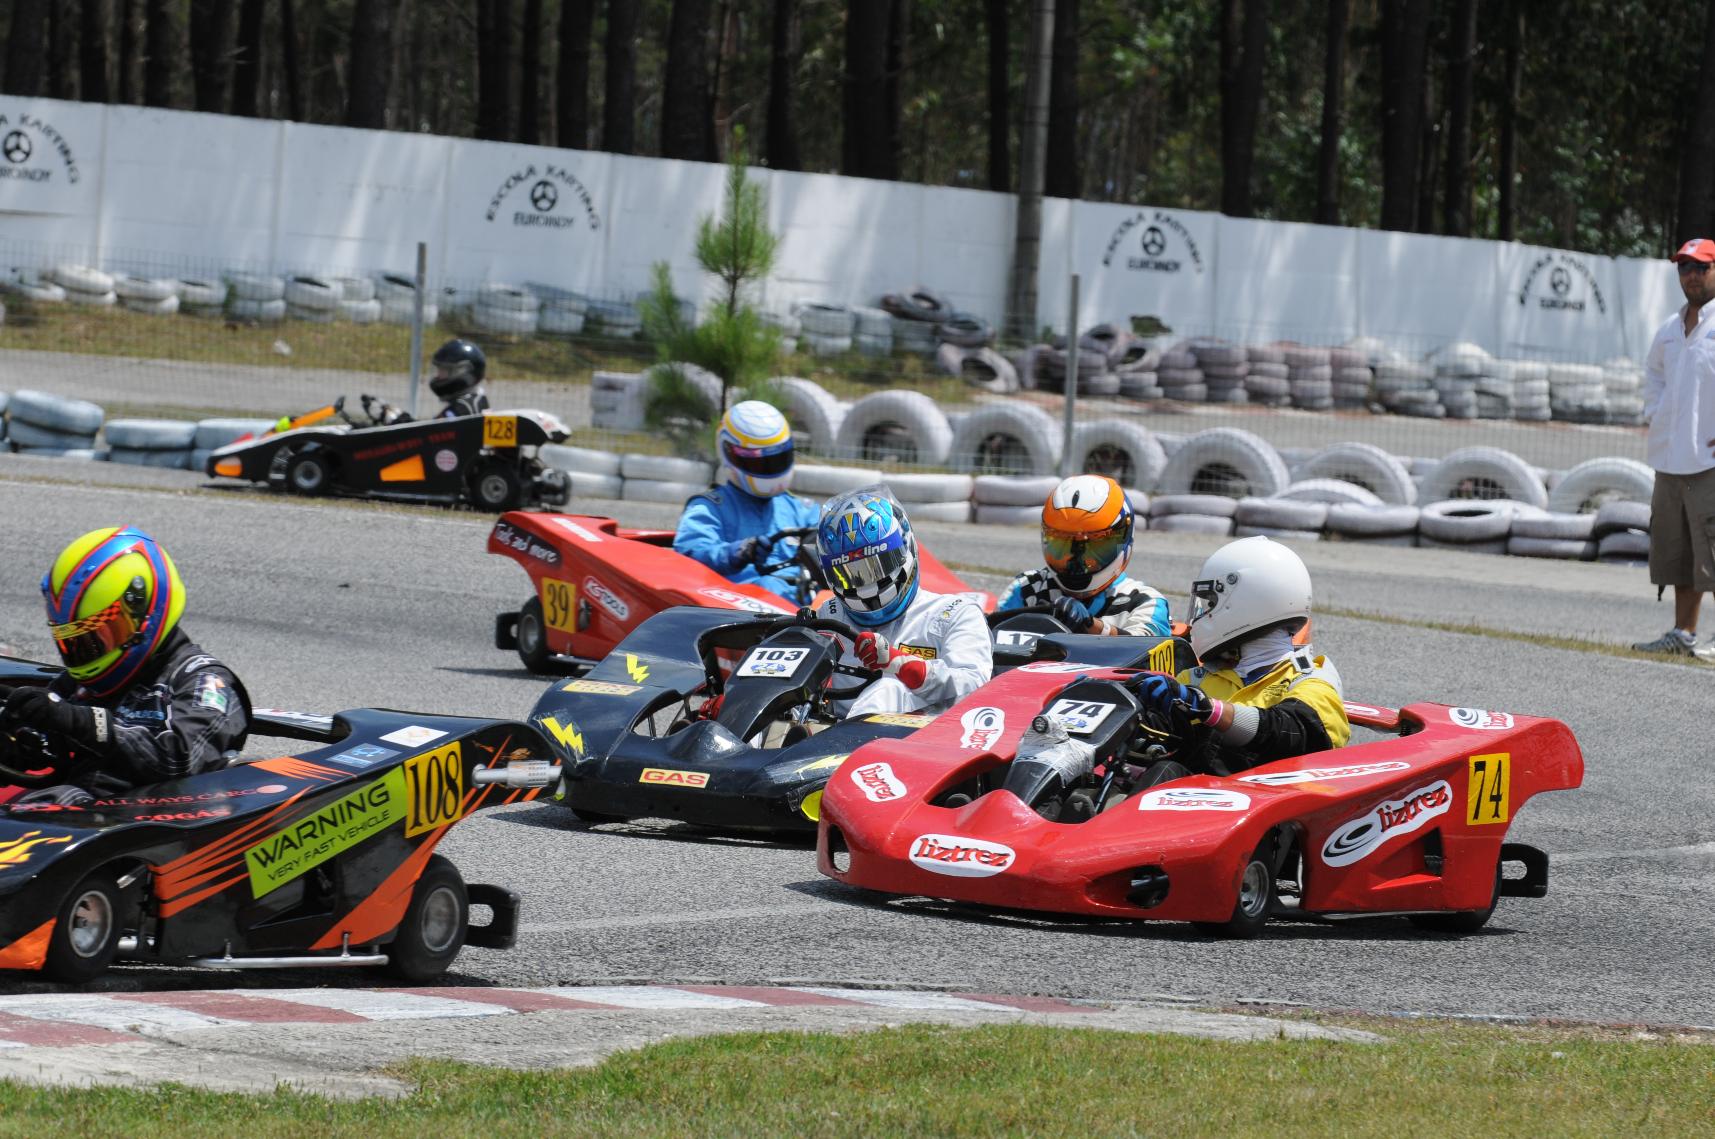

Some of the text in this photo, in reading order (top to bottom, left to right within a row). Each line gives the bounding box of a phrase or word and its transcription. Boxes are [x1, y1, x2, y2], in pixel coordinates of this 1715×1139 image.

[20, 113, 80, 184] KARTING
[486, 164, 600, 230] ESCOLA KARTING
[486, 419, 514, 440] 128
[546, 583, 571, 629] 39
[756, 650, 804, 661] 103
[1057, 701, 1105, 718] 74
[137, 795, 194, 804] WAYS
[409, 753, 461, 831] 108
[643, 770, 706, 786] GAS
[857, 764, 896, 799] liztrez
[1473, 759, 1503, 820] 74
[252, 782, 390, 869] WARNING
[1376, 784, 1450, 832] liztrez
[268, 809, 390, 881] VERY FAST VEHICLE
[914, 837, 1011, 867] liztrez
